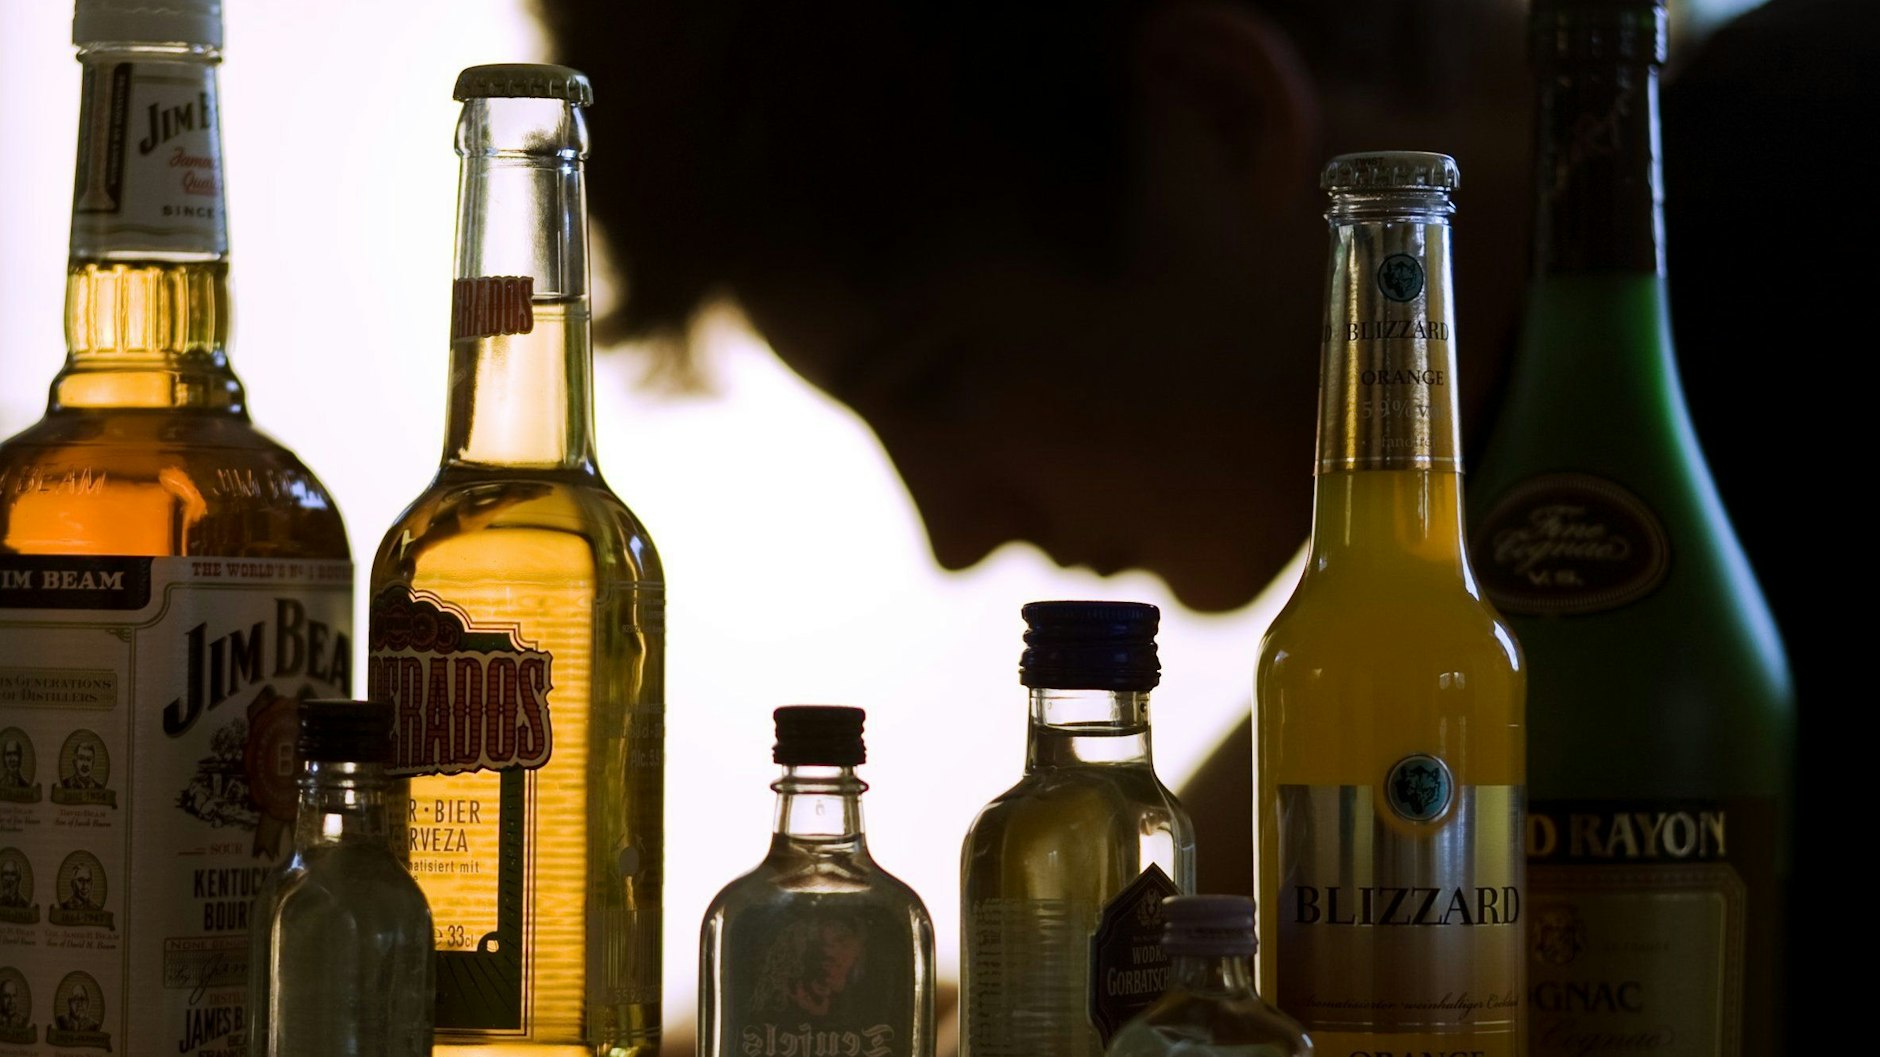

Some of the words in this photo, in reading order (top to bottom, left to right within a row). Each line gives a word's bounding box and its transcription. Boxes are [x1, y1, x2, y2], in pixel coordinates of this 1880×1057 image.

[139, 103, 194, 155] JIM
[161, 205, 216, 219] SINCE
[1346, 320, 1450, 342] BLIZZARD
[1361, 369, 1445, 387] ORANGE
[192, 561, 222, 577] THE
[41, 570, 125, 591] BEAM
[15, 674, 112, 689] GENERATIONS
[163, 622, 267, 738] JIM
[435, 799, 481, 824] BIER
[1568, 810, 1728, 859] RAYON
[210, 843, 243, 855] SOUR
[459, 860, 480, 874] mit
[204, 899, 254, 931] BOUR
[1294, 885, 1520, 926] BLIZZARD
[170, 939, 206, 949] NONE
[1528, 979, 1644, 1014] GNAC
[179, 1006, 232, 1054] JAMES
